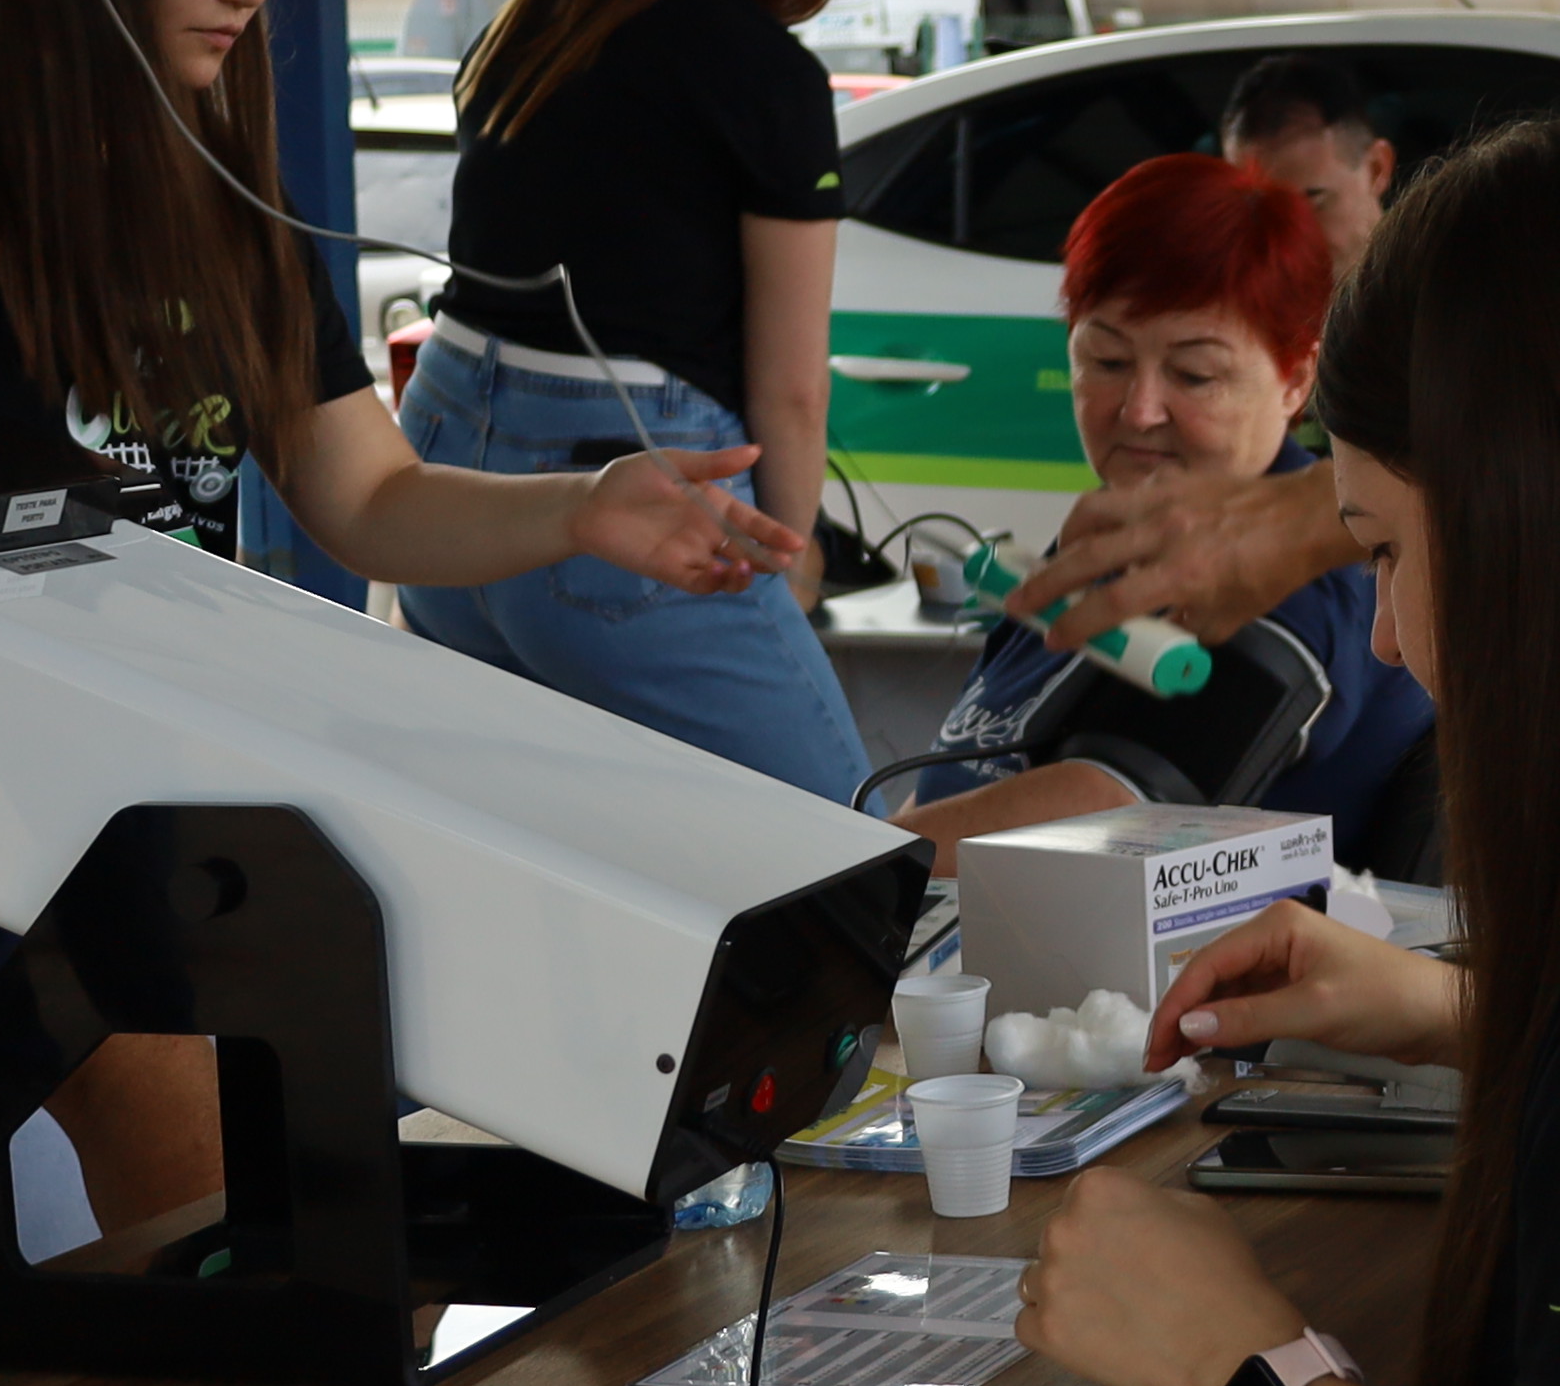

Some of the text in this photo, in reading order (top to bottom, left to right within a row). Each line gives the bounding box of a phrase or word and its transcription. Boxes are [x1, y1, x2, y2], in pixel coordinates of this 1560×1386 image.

[1153, 845, 1259, 892] ACCU-CHEK
[1153, 880, 1239, 910] Safe-T-Pro Uno
